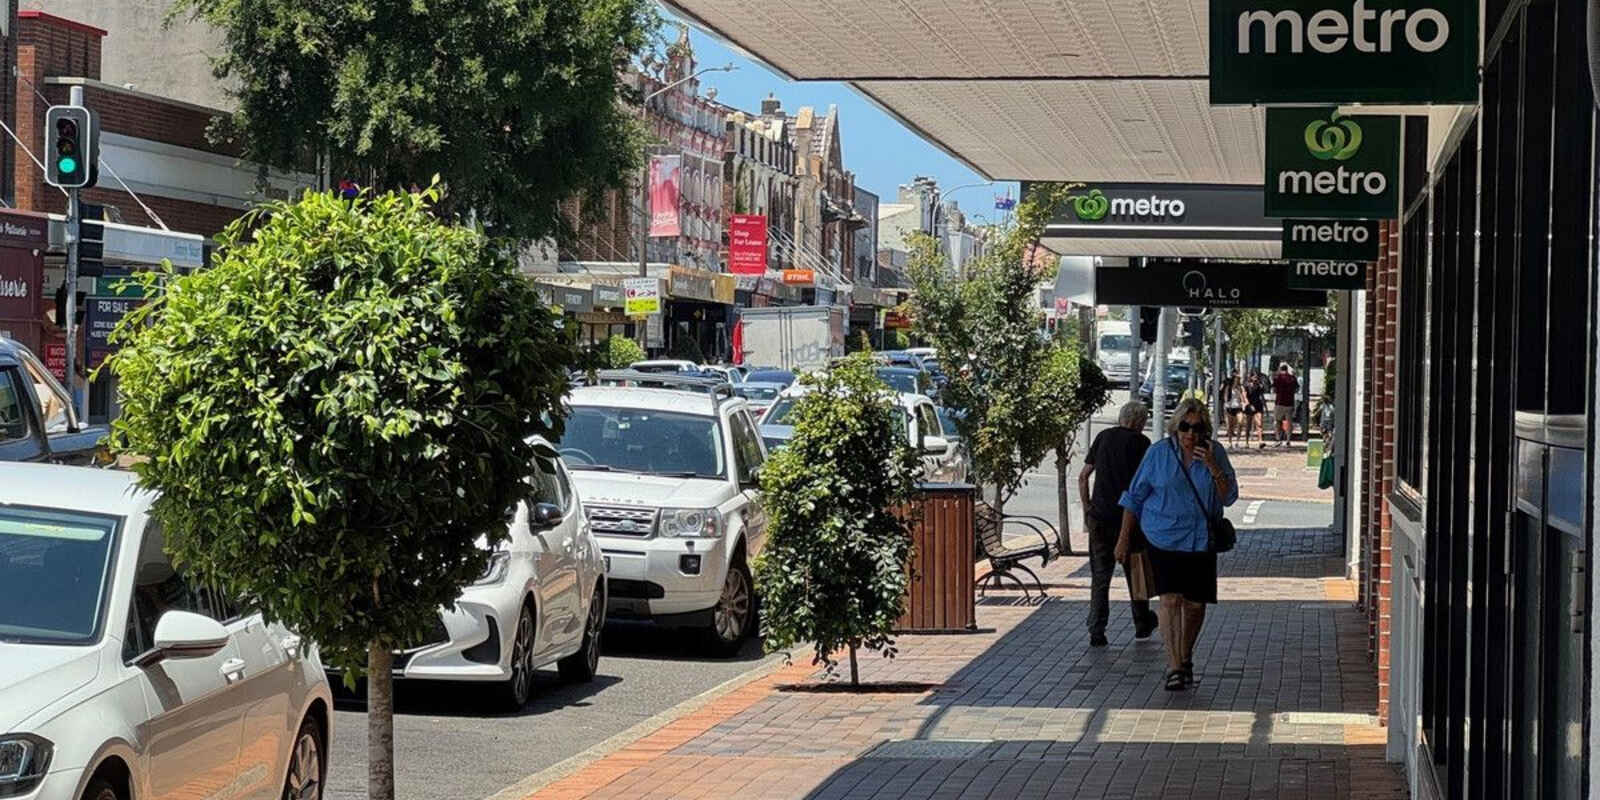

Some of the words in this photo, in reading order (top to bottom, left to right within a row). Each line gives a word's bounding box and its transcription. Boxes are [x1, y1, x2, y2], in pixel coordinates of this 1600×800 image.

[1237, 0, 1450, 53] metro
[1278, 166, 1387, 195] metro
[1111, 195, 1185, 217] metro
[1291, 222, 1369, 243] metro
[1296, 260, 1359, 276] metro
[1189, 288, 1240, 298] HALO
[98, 301, 111, 312] FOR
[112, 302, 128, 313] SALE
